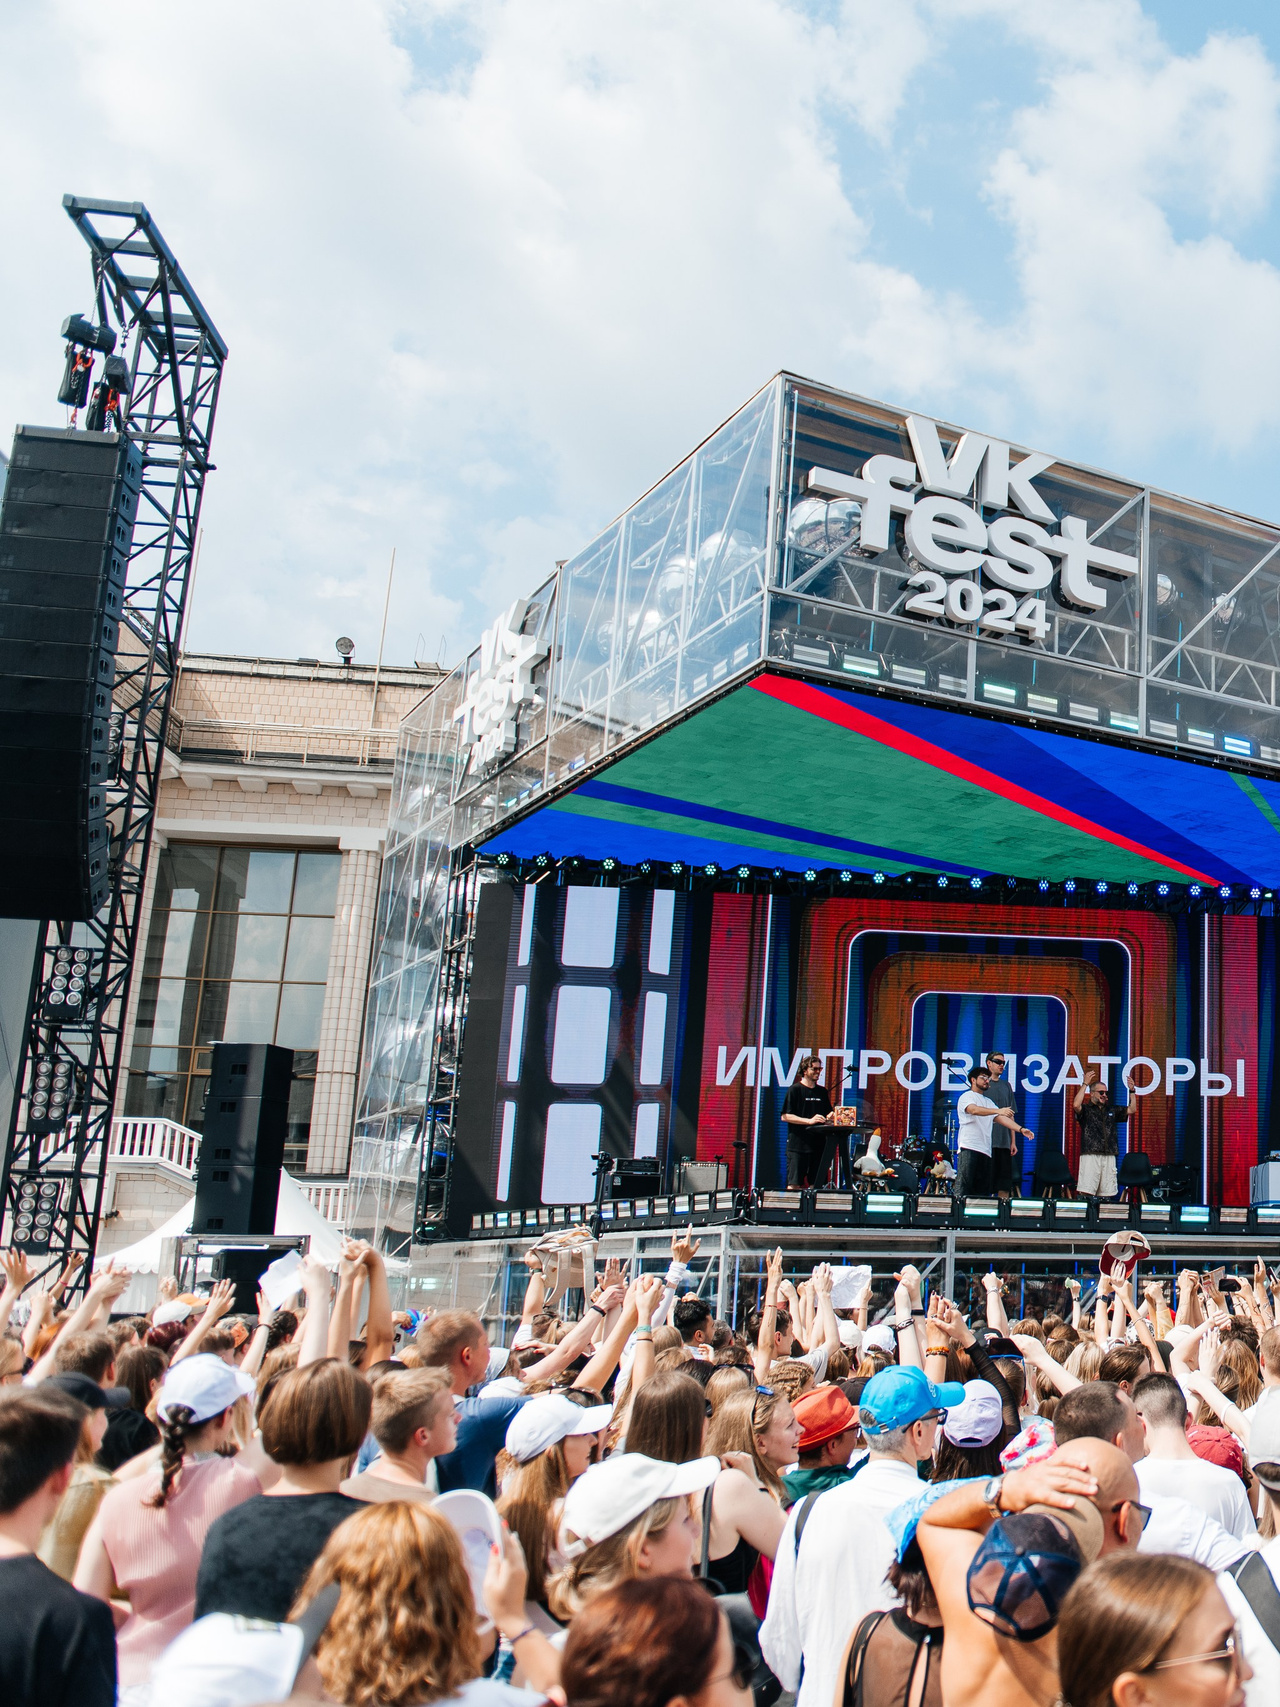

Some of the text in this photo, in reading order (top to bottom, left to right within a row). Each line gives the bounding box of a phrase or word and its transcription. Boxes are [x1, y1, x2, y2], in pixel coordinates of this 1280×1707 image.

[905, 415, 1058, 524] VK
[808, 454, 1139, 609] fest
[905, 571, 1051, 640] 2024
